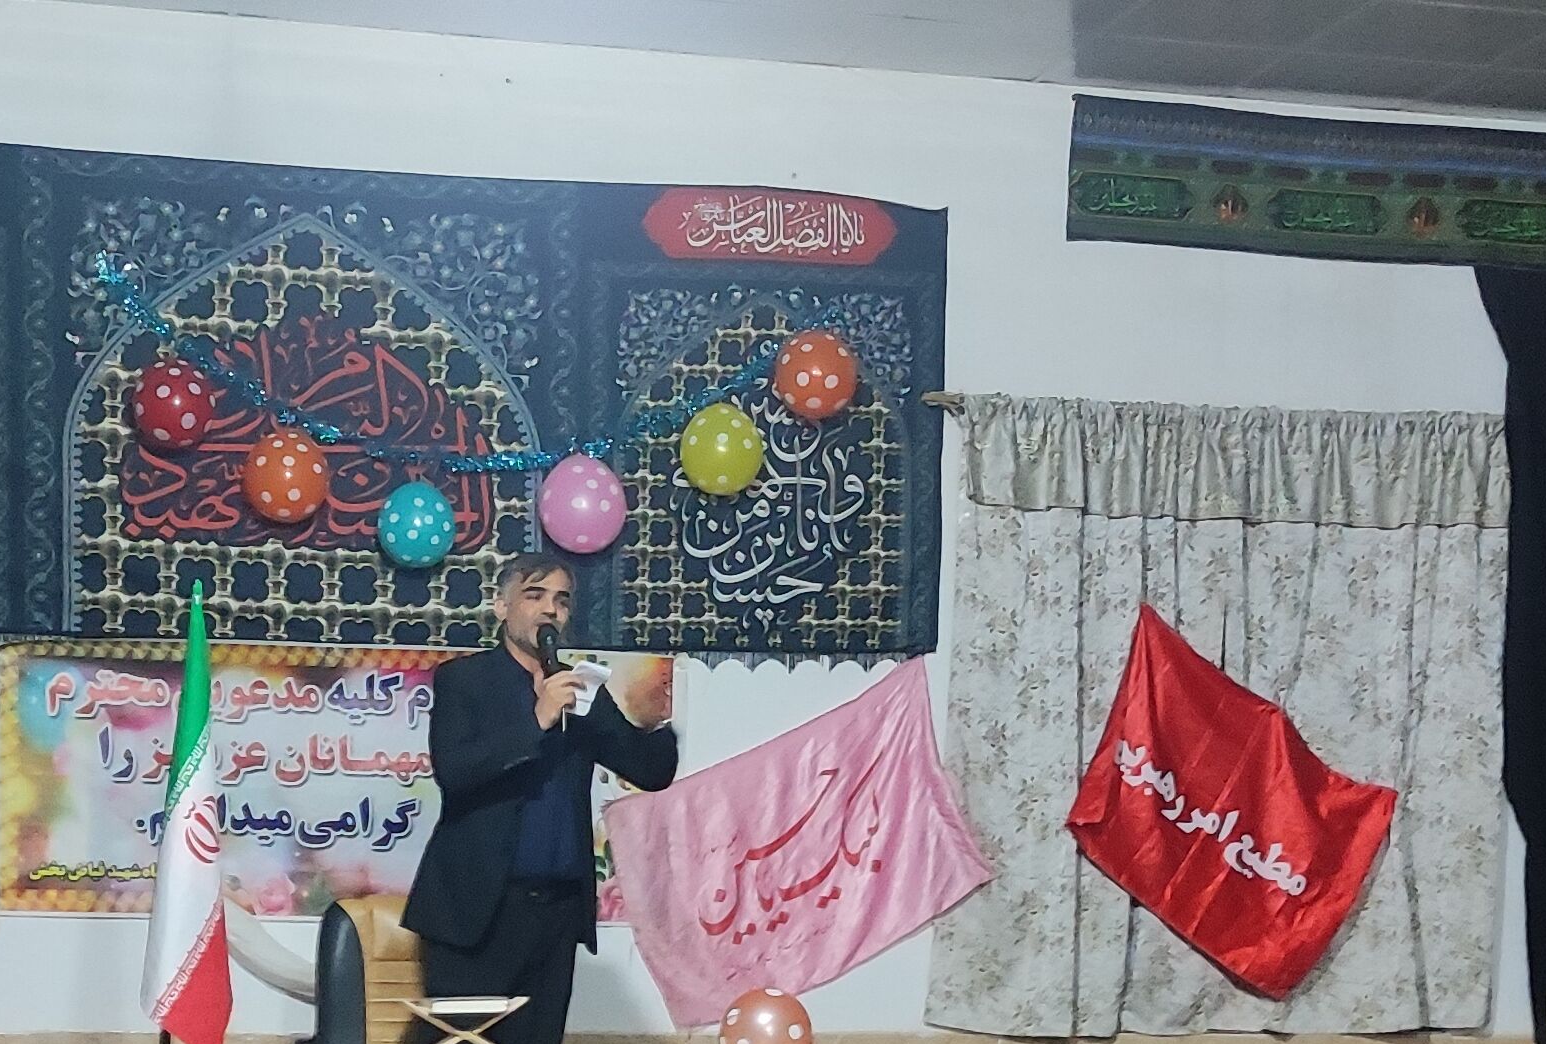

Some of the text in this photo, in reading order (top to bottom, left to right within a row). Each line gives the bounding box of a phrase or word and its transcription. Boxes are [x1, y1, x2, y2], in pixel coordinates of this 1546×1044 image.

[46, 670, 170, 717] محترم
[172, 676, 322, 721] مدعوی
[327, 672, 402, 723] کلیه
[97, 725, 134, 782] را
[141, 737, 268, 784] عزز
[273, 733, 433, 785] مهمانان
[135, 791, 421, 849] گرامی میدام.
[1175, 807, 1240, 843] امر
[107, 862, 142, 883] شهید
[1221, 834, 1307, 897] مطیع
